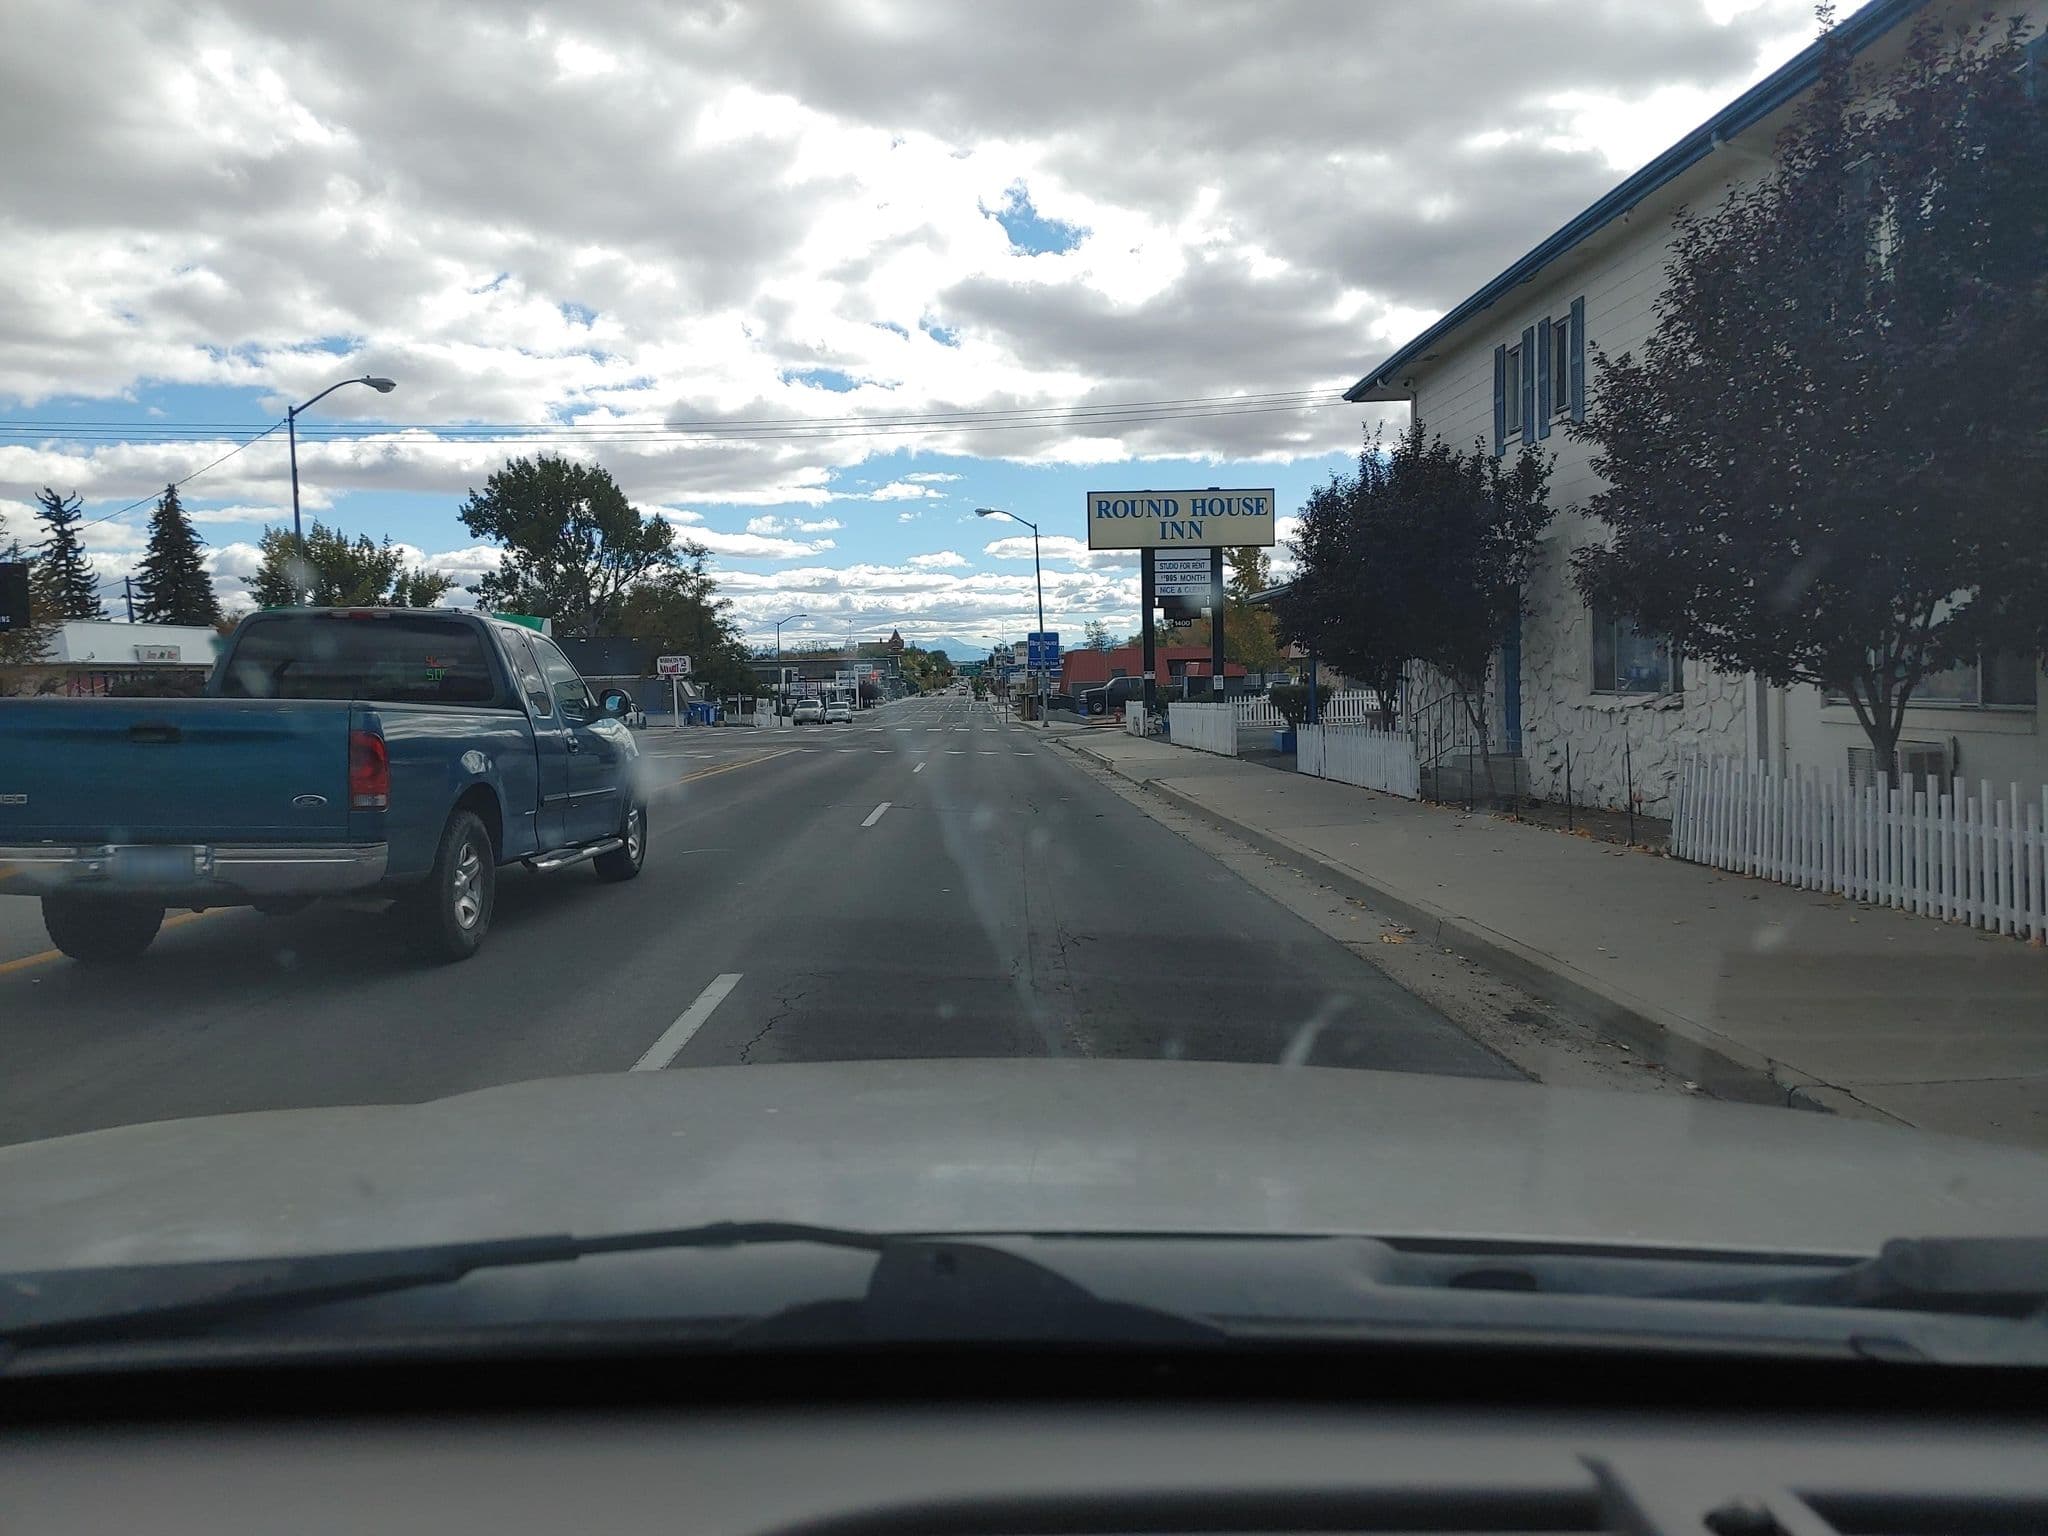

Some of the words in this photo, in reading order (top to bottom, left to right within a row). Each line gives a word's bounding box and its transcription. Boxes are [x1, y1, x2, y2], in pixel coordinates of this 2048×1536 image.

[1096, 499, 1179, 518] ROUND
[1191, 497, 1268, 516] HOUSE
[1160, 521, 1204, 540] INN
[1160, 562, 1178, 570] STUDIO
[1180, 562, 1190, 570] FOR
[1180, 574, 1206, 582] MONTH
[1160, 586, 1175, 594] NICE
